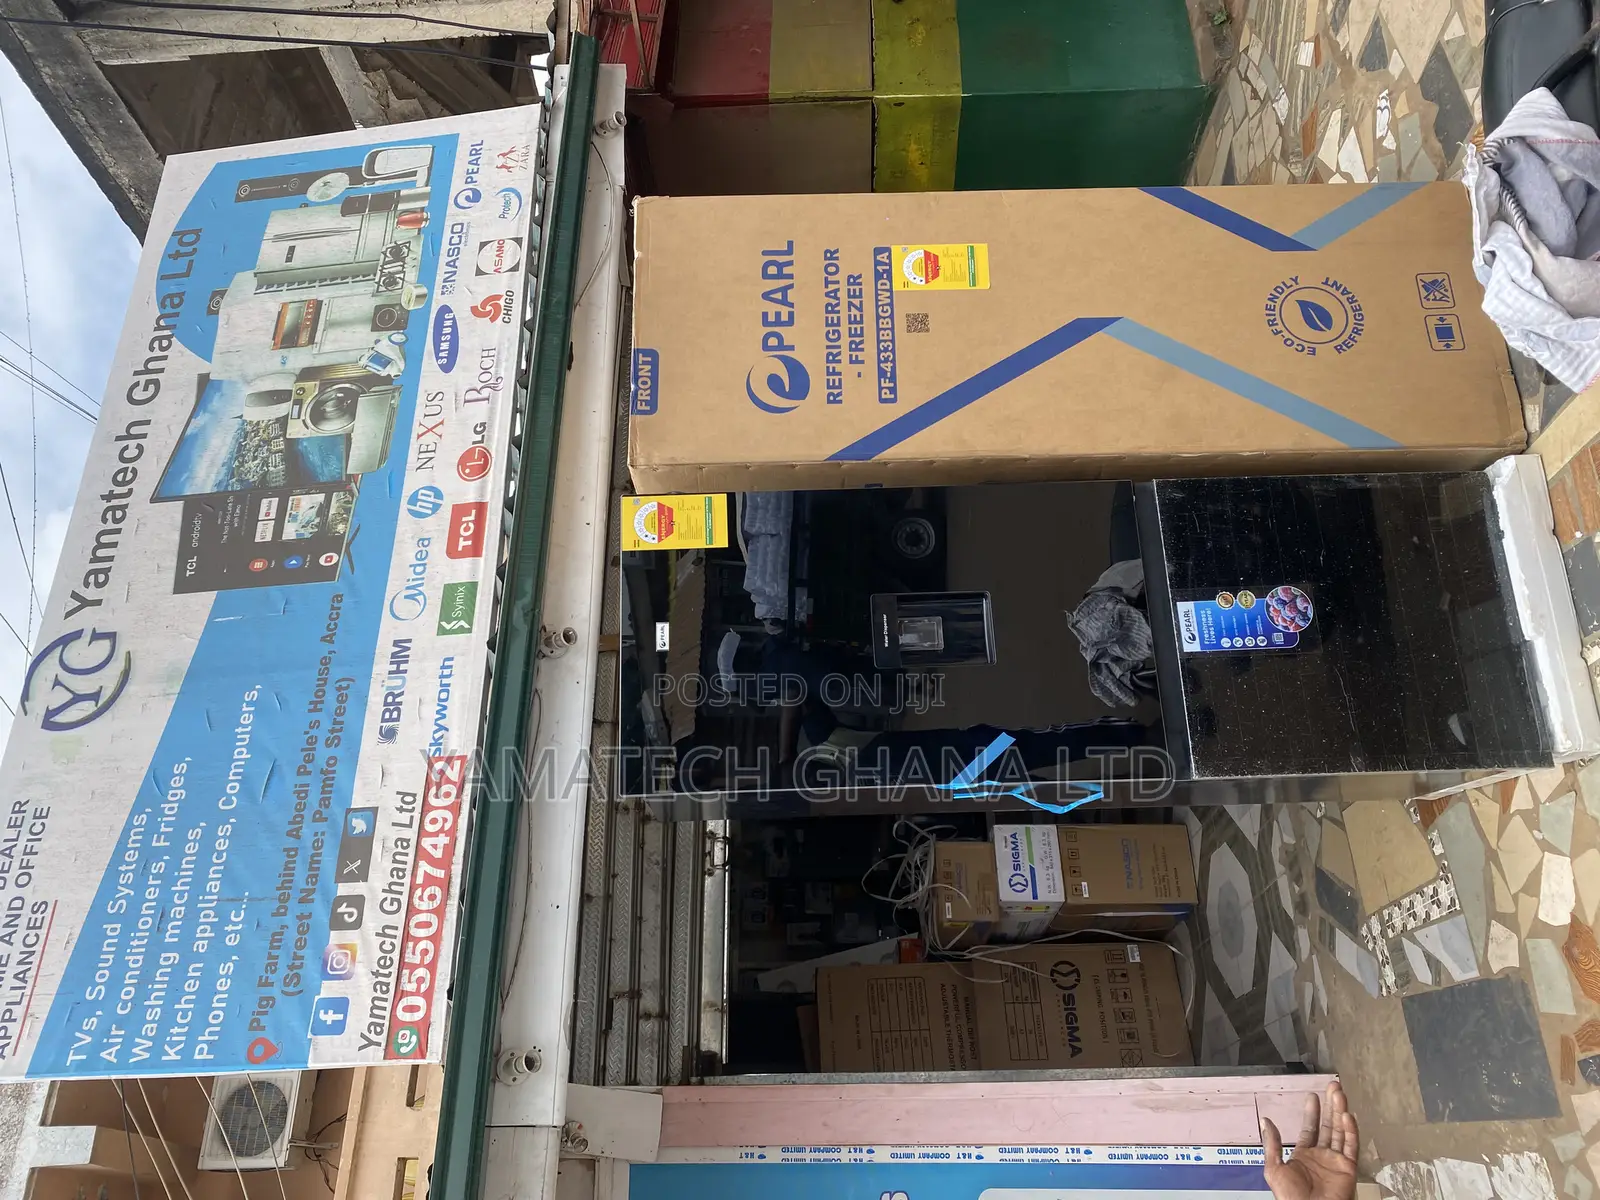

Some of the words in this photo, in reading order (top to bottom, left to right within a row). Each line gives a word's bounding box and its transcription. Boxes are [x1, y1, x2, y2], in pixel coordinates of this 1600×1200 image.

[464, 139, 484, 184] PEARL
[519, 144, 531, 171] ZARA
[498, 192, 512, 219] Protech
[442, 222, 465, 284] NASCO
[493, 239, 506, 274] ASANO
[502, 290, 515, 324] CHIGO
[761, 240, 795, 352] PEARL
[823, 247, 843, 405] REFRIGERATOR
[846, 273, 865, 365] FREEZER
[876, 251, 895, 399] PF-433BBGWD-1A
[1265, 275, 1317, 356] ECO-FRIENDLY
[1321, 276, 1365, 355] REFRIGERANT
[437, 312, 455, 365] SAMSUNG
[636, 352, 652, 411] FRONT
[63, 419, 152, 620] Yamatech
[126, 291, 186, 406] Ghana
[160, 228, 203, 280] Ltd
[415, 391, 445, 472] NEXUS
[472, 421, 487, 445] LG
[407, 488, 443, 515] hp
[457, 509, 477, 551] TCL
[185, 555, 197, 577] TCL
[403, 537, 432, 609] Midea
[320, 593, 344, 644] Accra
[451, 585, 466, 617] Syinix
[1183, 608, 1193, 633] PEARL
[1200, 609, 1211, 645] Freshness
[307, 650, 337, 713] House,
[324, 677, 355, 748] Street)
[380, 638, 412, 724] BRÜHM
[296, 719, 321, 777] Pele's
[286, 783, 310, 840] Abedi
[312, 756, 338, 823] Pamfo
[391, 790, 417, 829] Ltd
[0, 896, 25, 947] AND
[14, 806, 51, 889] OFFICE
[162, 963, 204, 1061] Kitchen
[193, 818, 236, 953] appliances,
[218, 684, 262, 810] Computers,
[271, 847, 299, 917] behind
[297, 831, 326, 904] Name:
[378, 838, 411, 915] Ghana
[1009, 832, 1022, 872] SIGMA
[100, 1023, 125, 1063] Air
[116, 855, 170, 1014] conditioners,
[152, 757, 192, 847] Fridges,
[396, 760, 461, 1023] 0550674962
[66, 1010, 103, 1066] TVs,
[86, 923, 122, 1000] Sound
[107, 808, 152, 914] Systems,
[128, 952, 179, 1063] Washing
[164, 822, 207, 942] machines,
[257, 924, 289, 988] Farm,
[281, 912, 312, 996] (Street
[194, 956, 239, 1060] Phones,
[224, 891, 249, 946] etc...
[357, 925, 399, 1052] Yamatech
[248, 996, 276, 1032] Pig
[1062, 993, 1082, 1058] SIGMA
